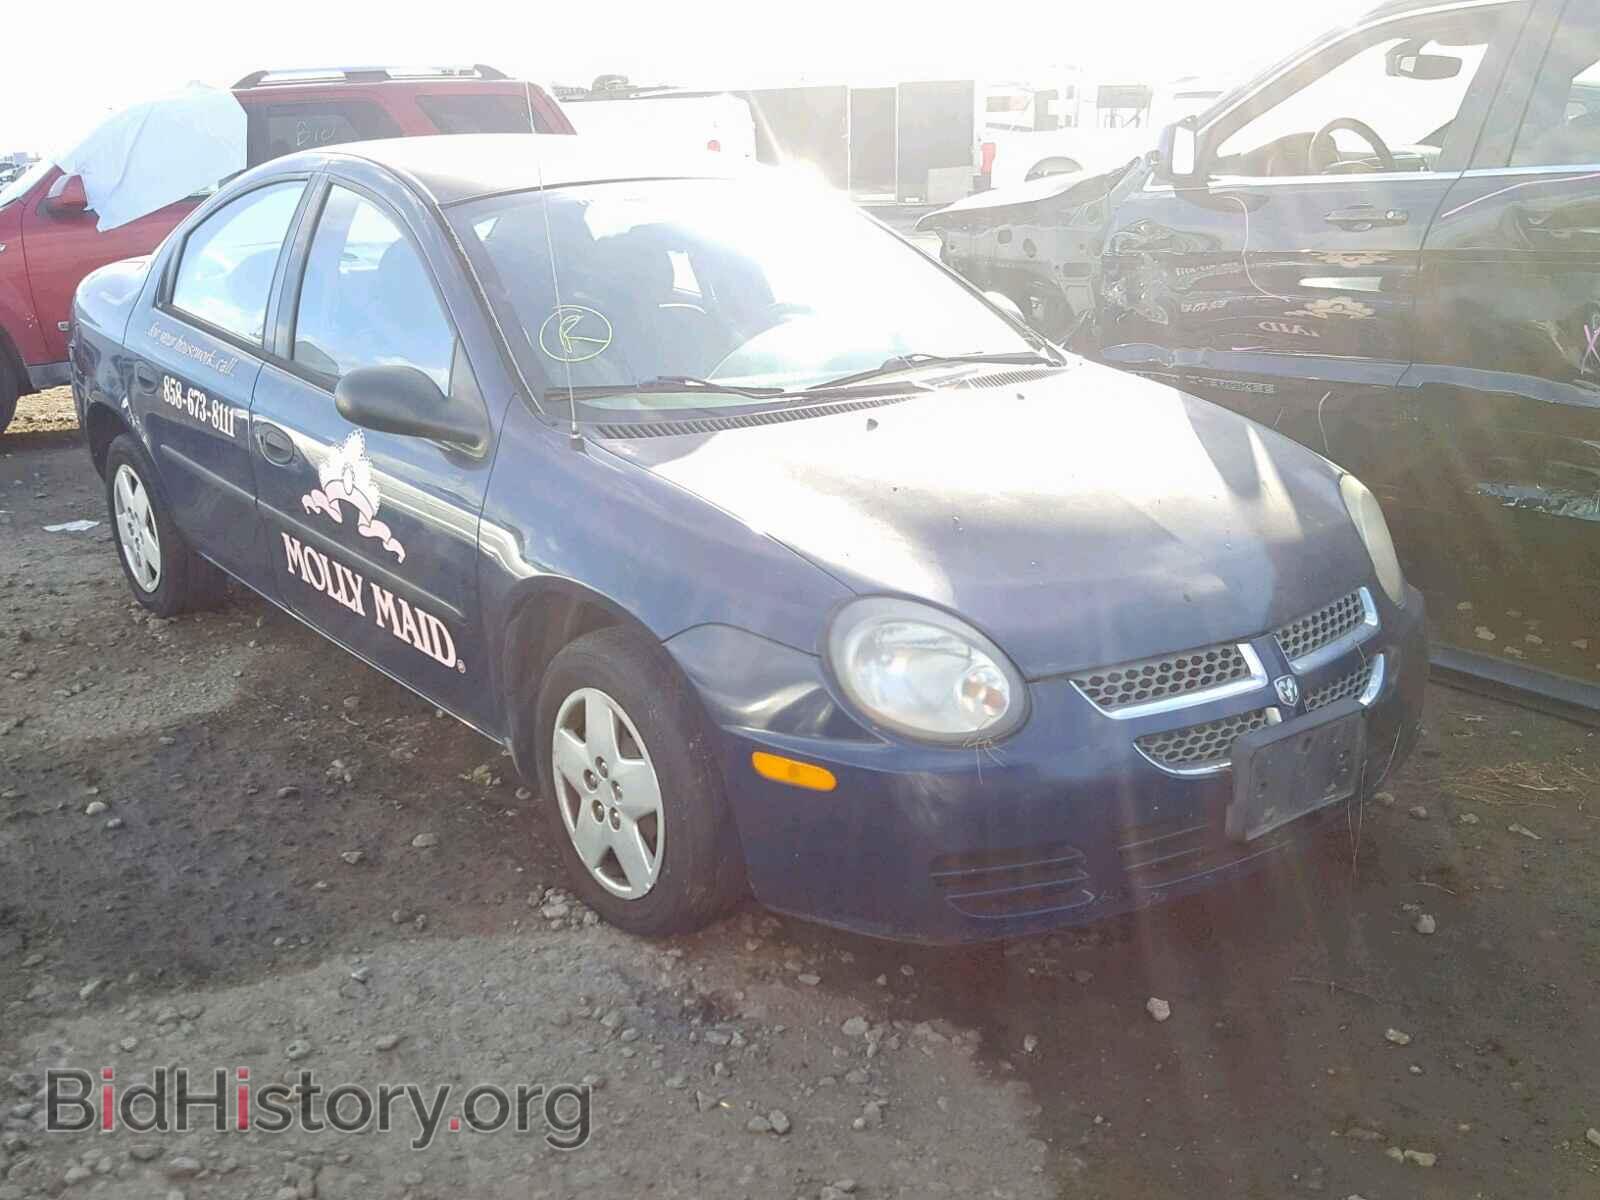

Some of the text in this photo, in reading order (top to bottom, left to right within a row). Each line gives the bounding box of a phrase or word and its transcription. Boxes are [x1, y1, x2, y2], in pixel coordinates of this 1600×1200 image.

[163, 375, 235, 437] 858-673-8111
[281, 532, 456, 668] MOLLY MAID
